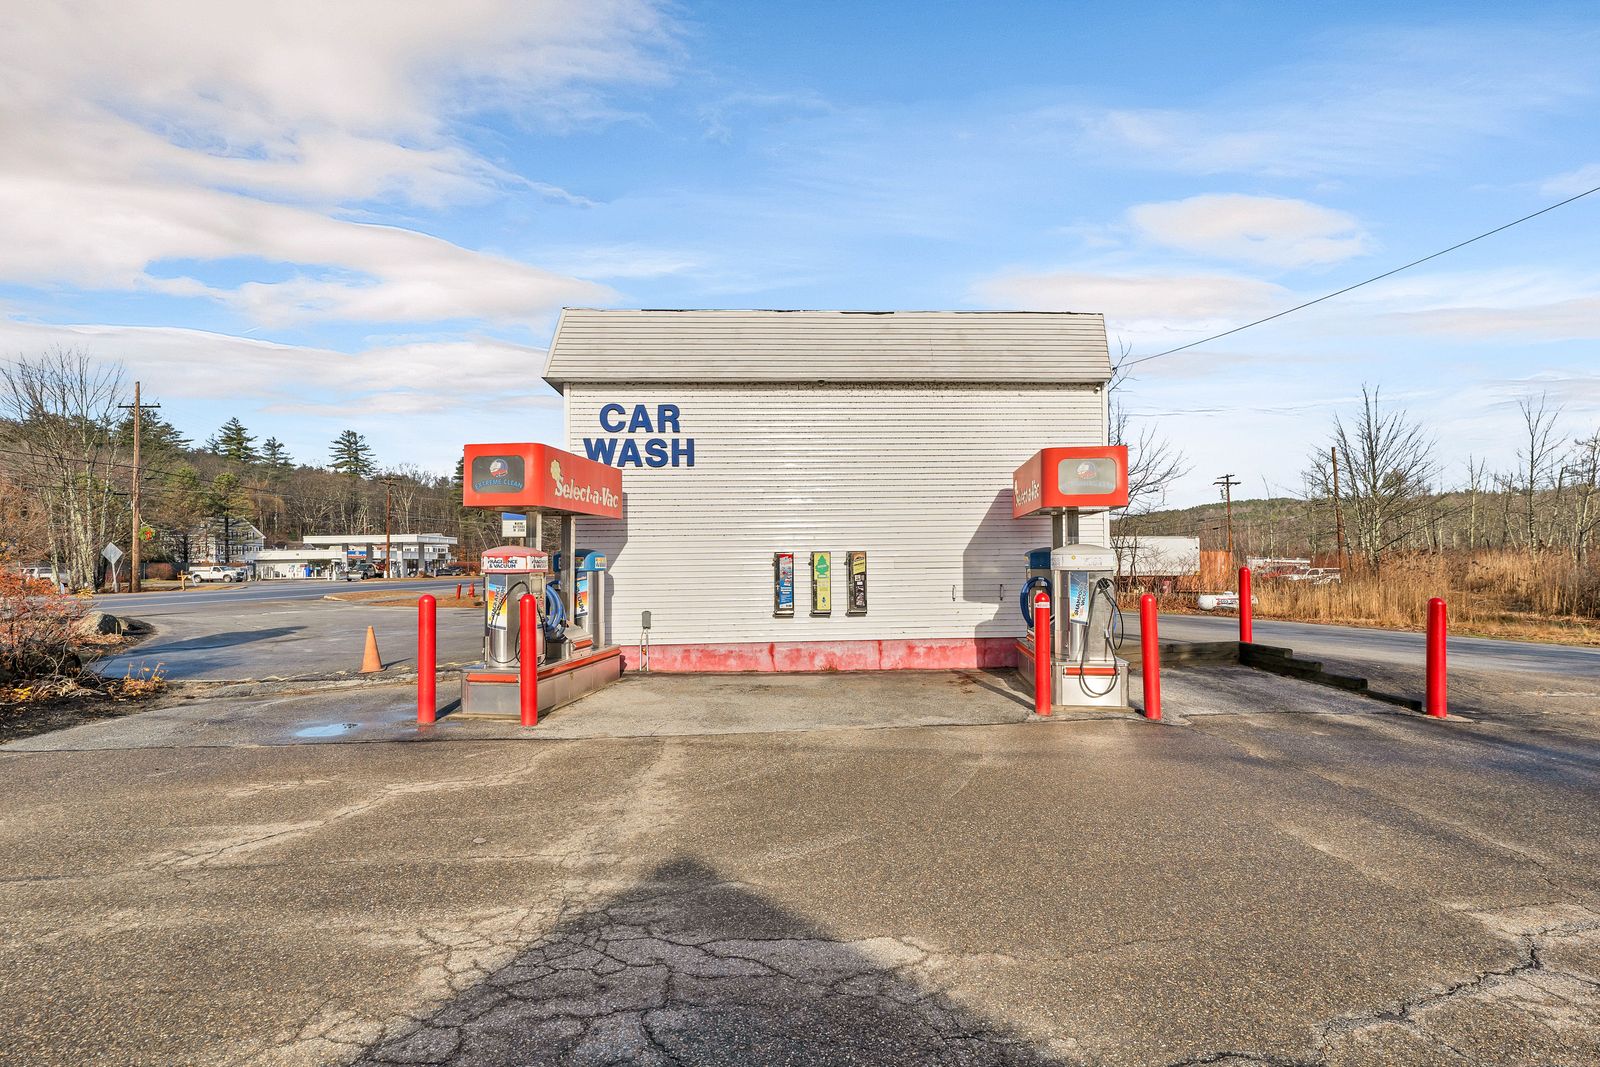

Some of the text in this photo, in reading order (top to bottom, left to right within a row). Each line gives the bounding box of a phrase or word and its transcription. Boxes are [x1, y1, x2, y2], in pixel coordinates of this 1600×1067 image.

[599, 403, 681, 433] CAR
[582, 438, 695, 468] WASH
[474, 478, 523, 490] EXTREME CLEAN
